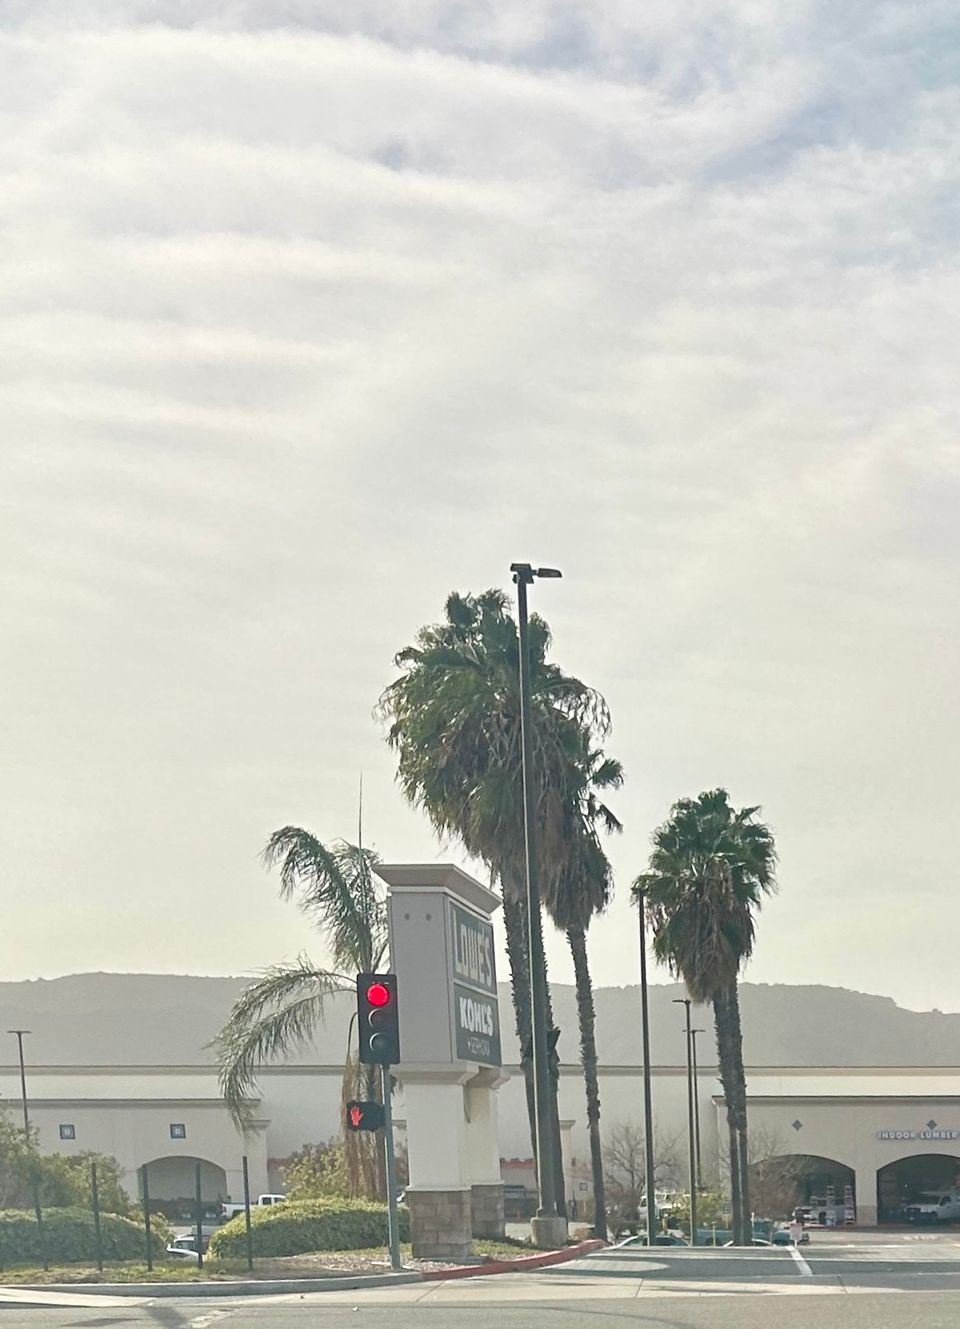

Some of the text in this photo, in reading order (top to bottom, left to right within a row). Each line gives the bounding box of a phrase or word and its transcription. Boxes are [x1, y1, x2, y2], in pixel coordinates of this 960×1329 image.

[453, 909, 493, 987] LOWE'S
[459, 996, 494, 1037] KOHL'S
[878, 1131, 917, 1140] INDOOR
[920, 1131, 958, 1140] LUMBER
